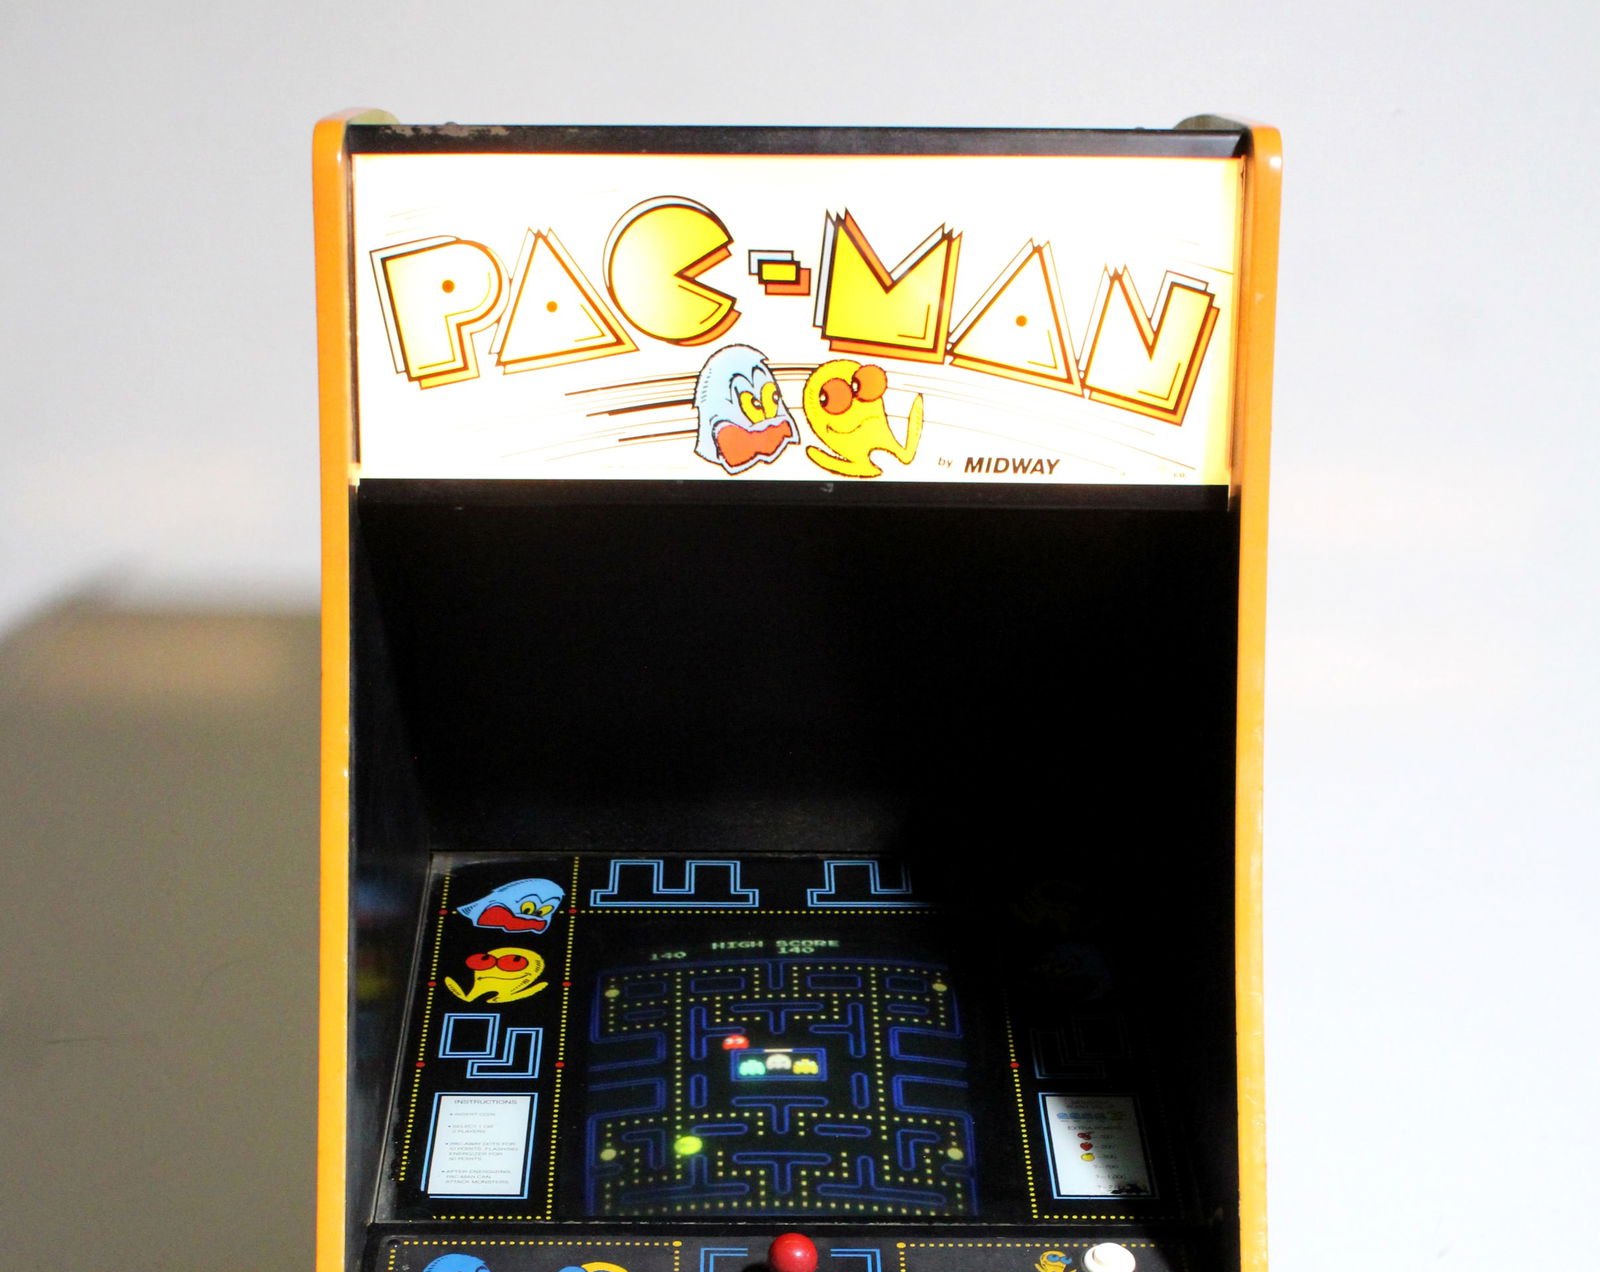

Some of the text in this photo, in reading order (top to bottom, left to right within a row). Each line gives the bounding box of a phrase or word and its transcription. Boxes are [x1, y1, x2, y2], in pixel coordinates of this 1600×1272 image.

[369, 196, 1220, 426] PAC-MAN
[938, 457, 1061, 475] by MIDWAY
[711, 939, 839, 950] HIGH SCORE
[778, 946, 815, 954] 140
[650, 951, 687, 961] 140
